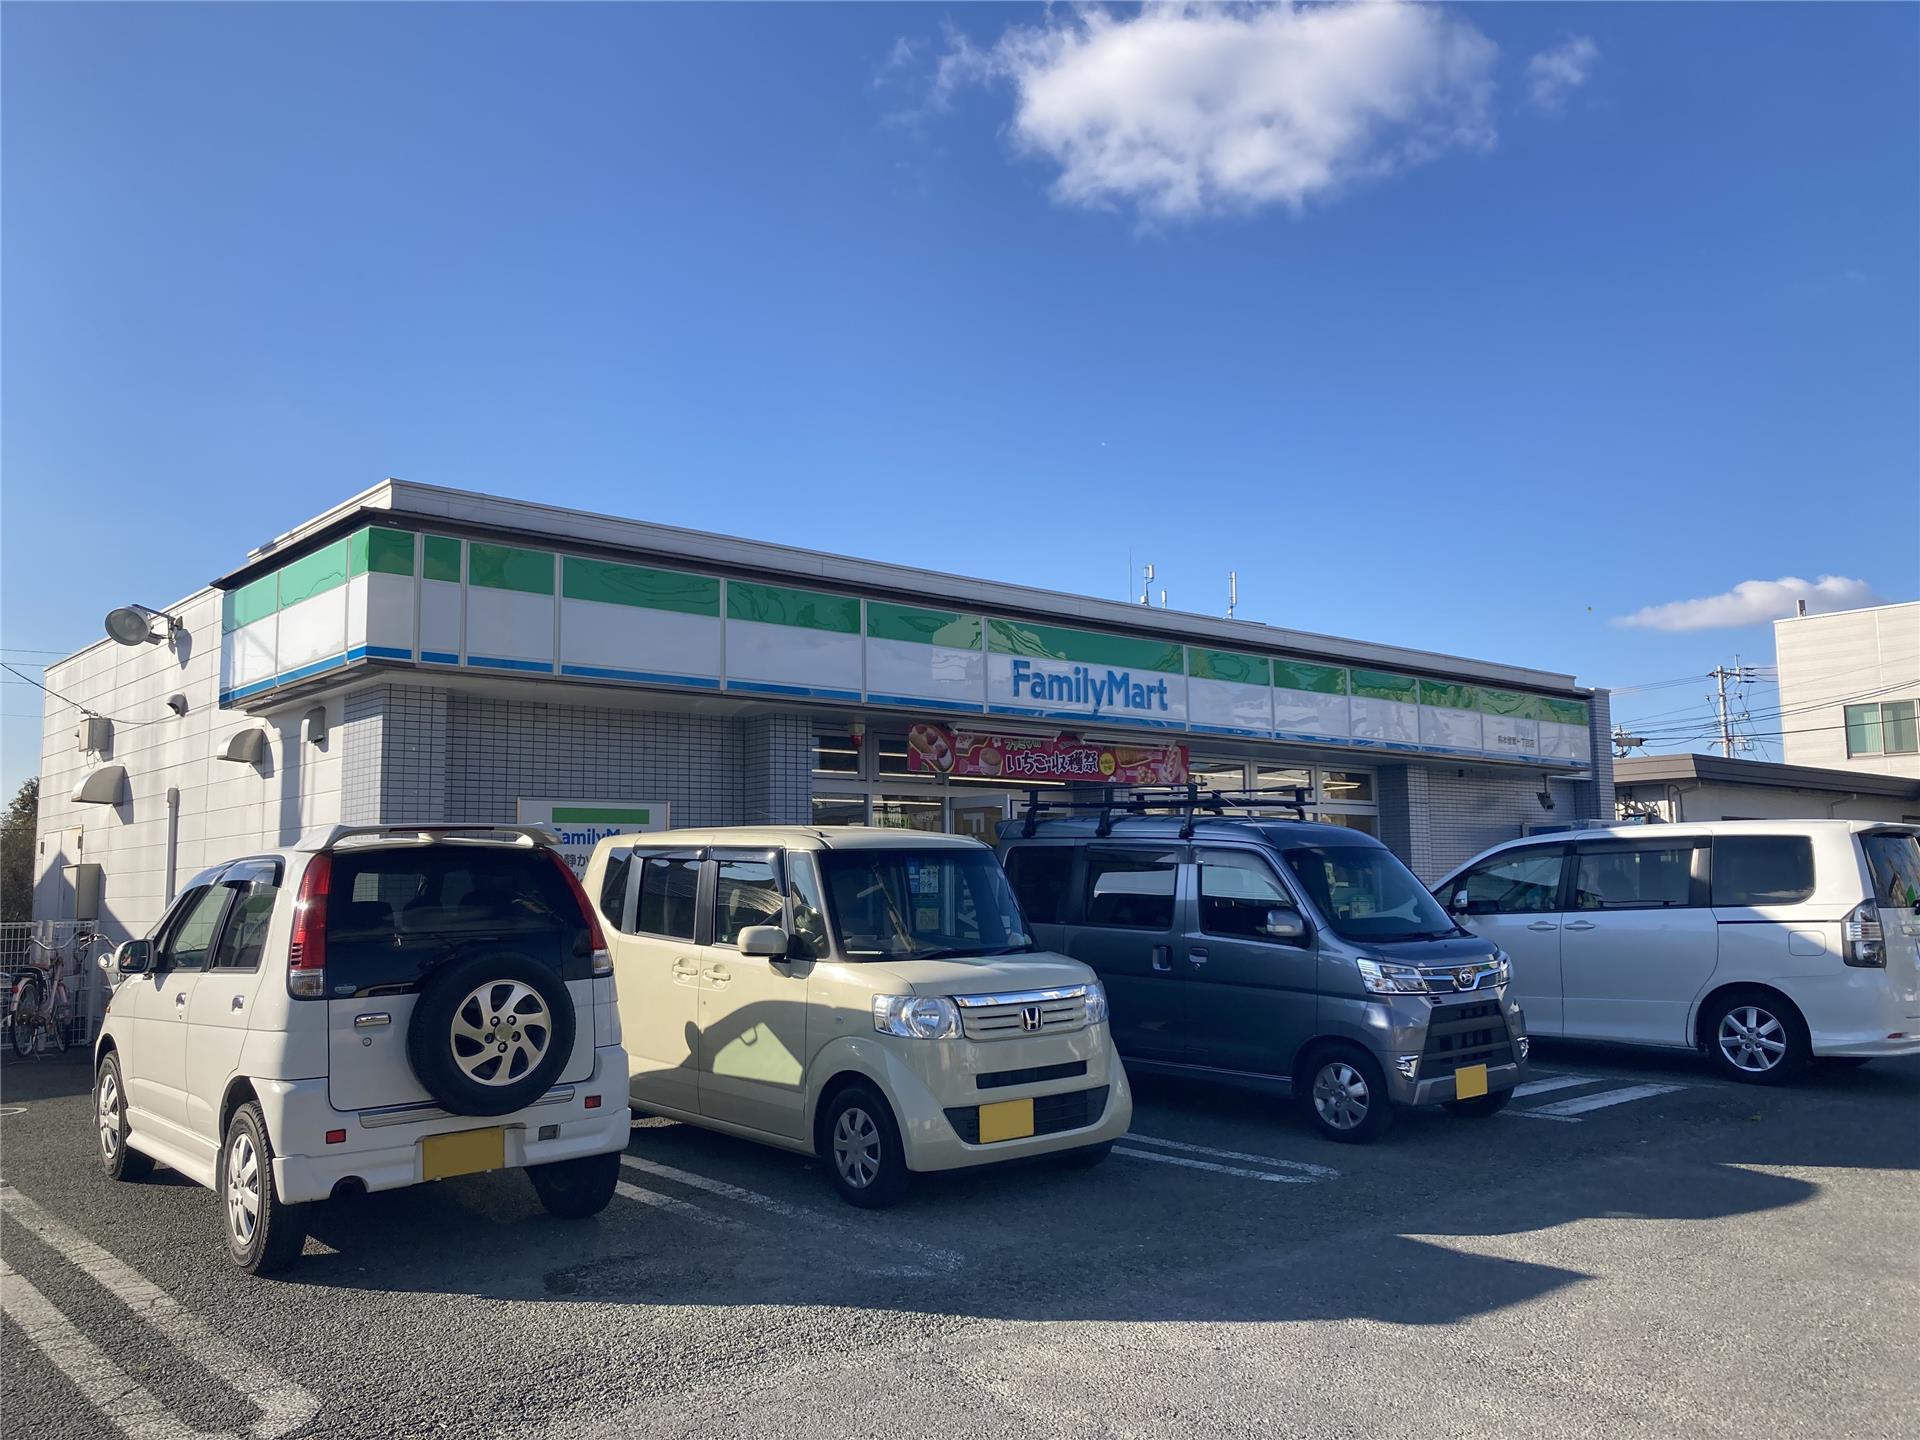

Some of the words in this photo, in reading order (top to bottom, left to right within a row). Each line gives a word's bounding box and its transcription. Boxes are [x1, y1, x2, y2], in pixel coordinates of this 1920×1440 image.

[1012, 659, 1168, 714] FamilyMart
[1006, 750, 1098, 774] いちご収穫祭
